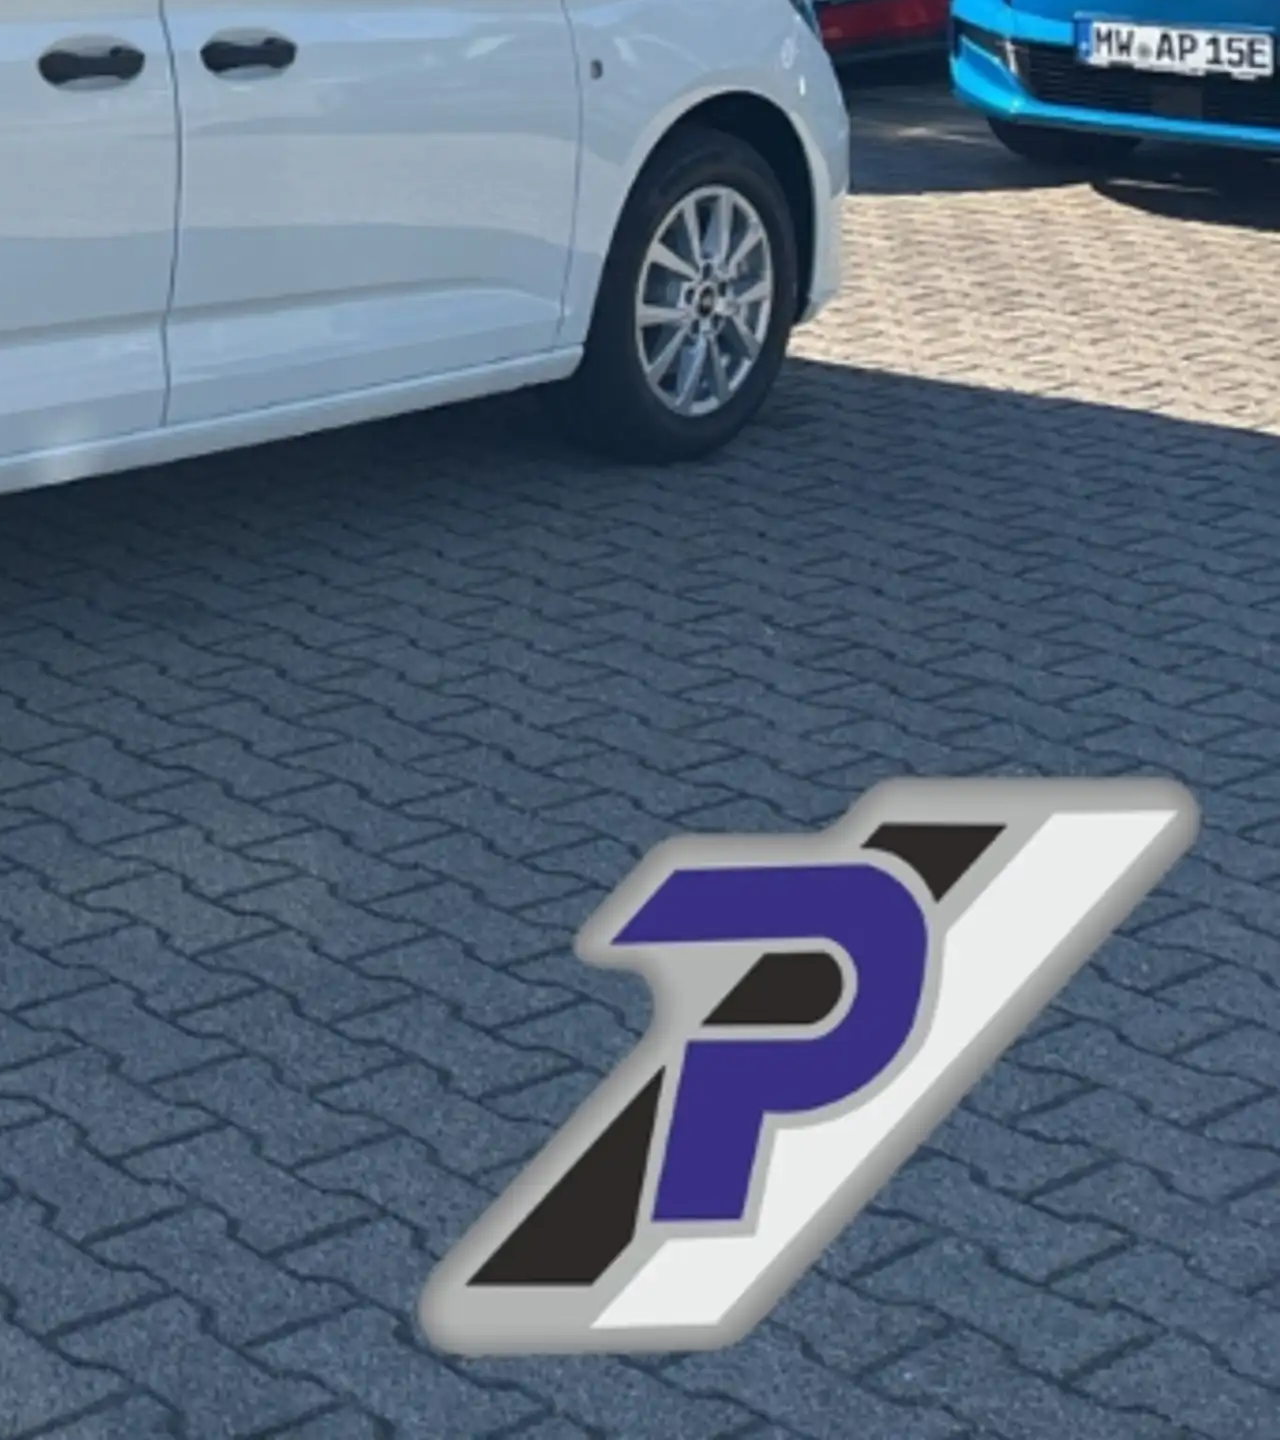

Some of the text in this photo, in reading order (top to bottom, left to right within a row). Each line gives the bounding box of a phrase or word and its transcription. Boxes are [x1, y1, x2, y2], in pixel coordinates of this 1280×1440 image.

[1095, 26, 1268, 69] MW AP 15E
